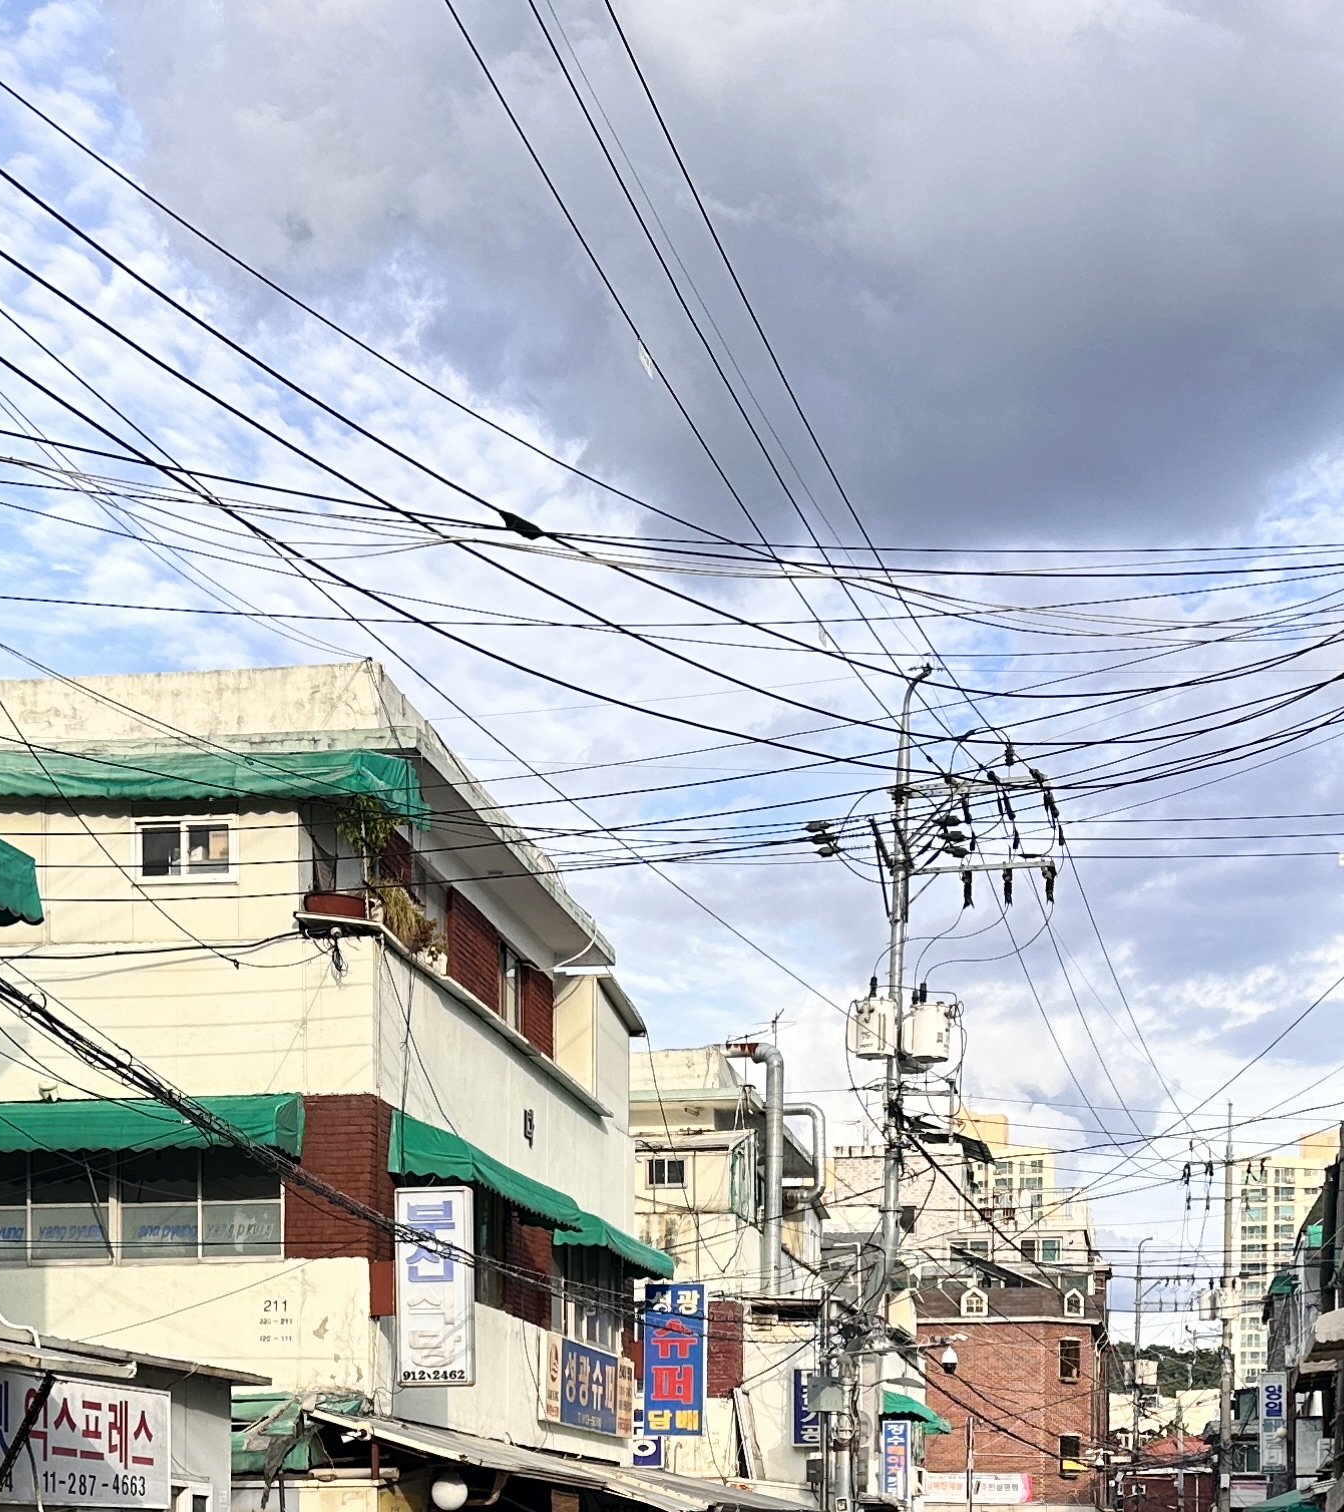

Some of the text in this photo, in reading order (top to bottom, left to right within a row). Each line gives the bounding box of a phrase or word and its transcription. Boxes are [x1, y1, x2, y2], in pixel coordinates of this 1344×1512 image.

[263, 1299, 287, 1313] 211
[653, 1289, 700, 1316] 성광
[651, 1319, 697, 1404] 슈퍼
[565, 1351, 616, 1415] 성광슈퍼
[1264, 1384, 1283, 1417] 영일
[25, 1387, 155, 1470] 익스프레스
[648, 1409, 699, 1431] 담배
